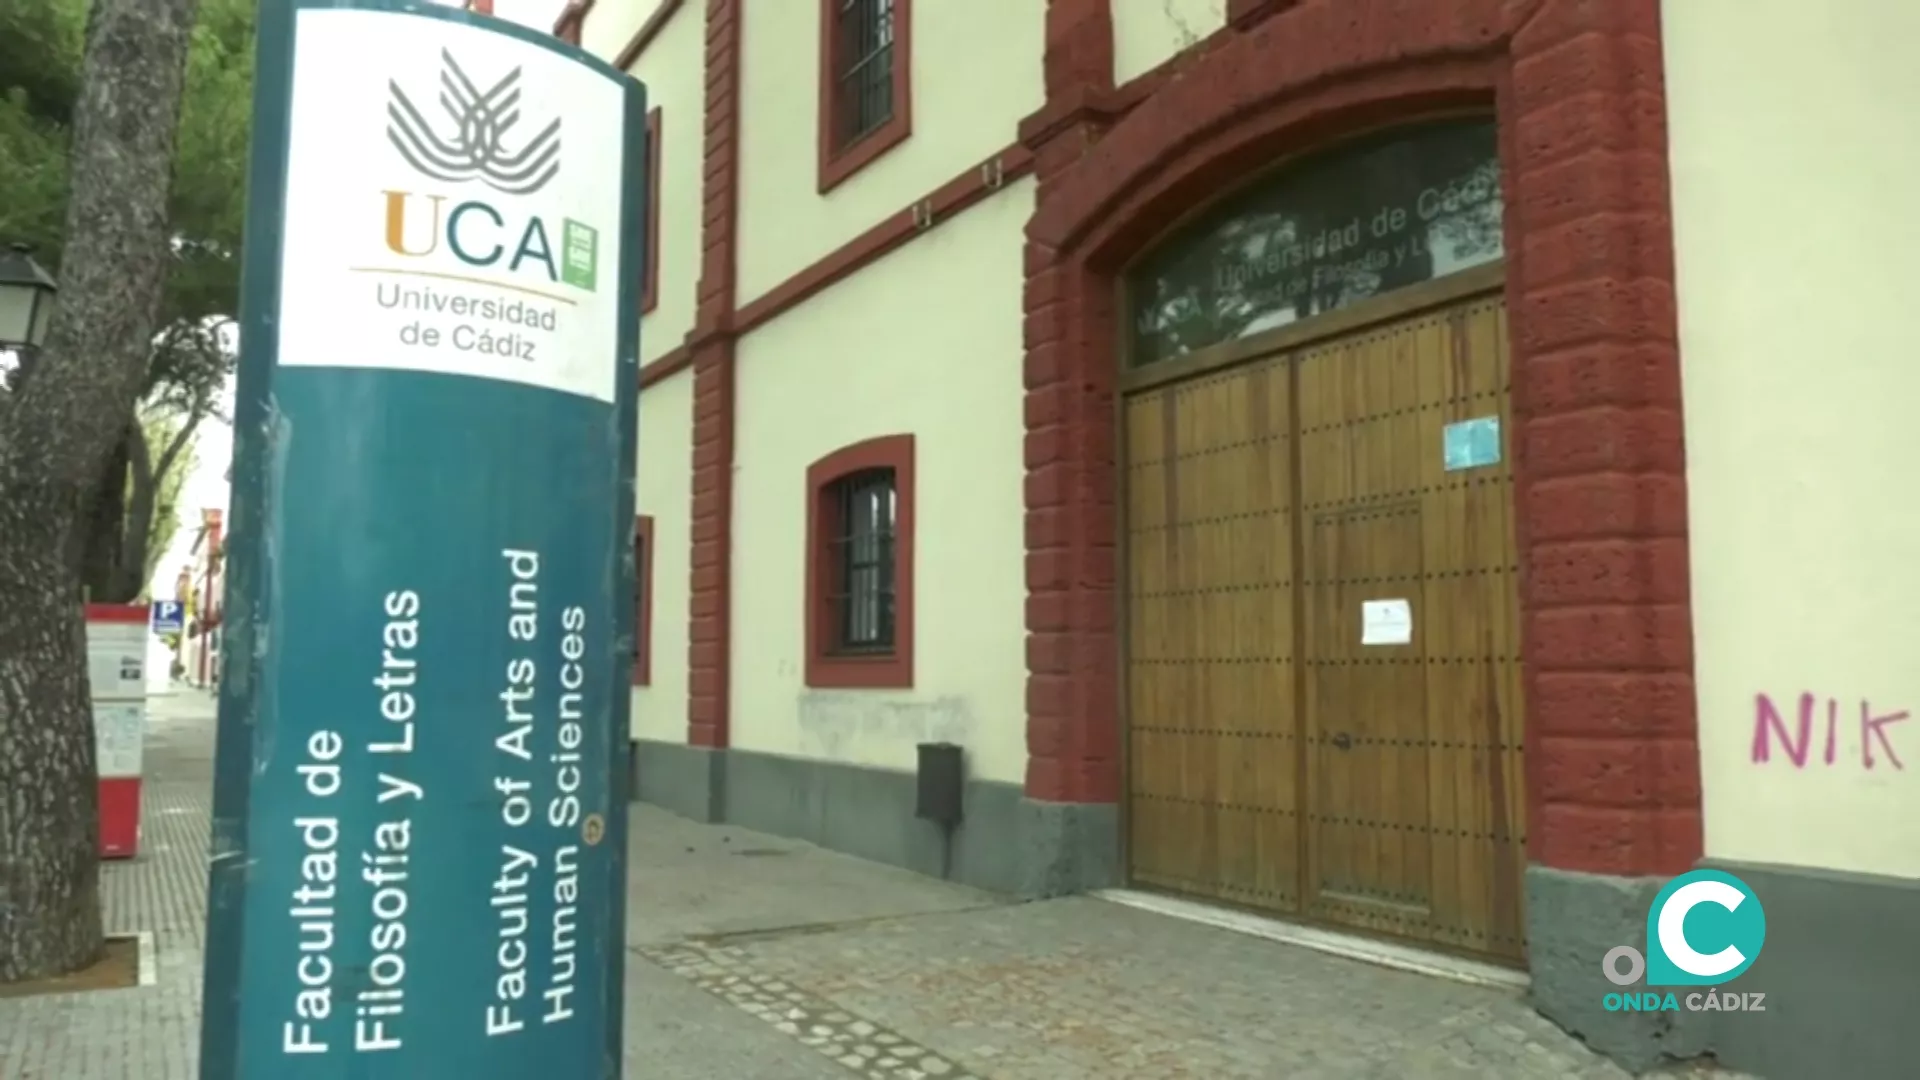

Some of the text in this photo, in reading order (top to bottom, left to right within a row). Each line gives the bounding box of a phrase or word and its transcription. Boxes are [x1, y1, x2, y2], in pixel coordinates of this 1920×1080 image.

[381, 190, 559, 283] UCA
[1215, 216, 1361, 288] Universidad
[1370, 206, 1407, 237] de
[376, 283, 557, 332] Universidad
[399, 321, 536, 363] de Cádiz
[161, 602, 178, 619] P
[354, 589, 425, 1053] Filosofía y Letras
[485, 548, 541, 1037] Faculty of Arts and
[542, 604, 587, 1025] Human Sciences
[282, 729, 343, 1055] Facultad de
